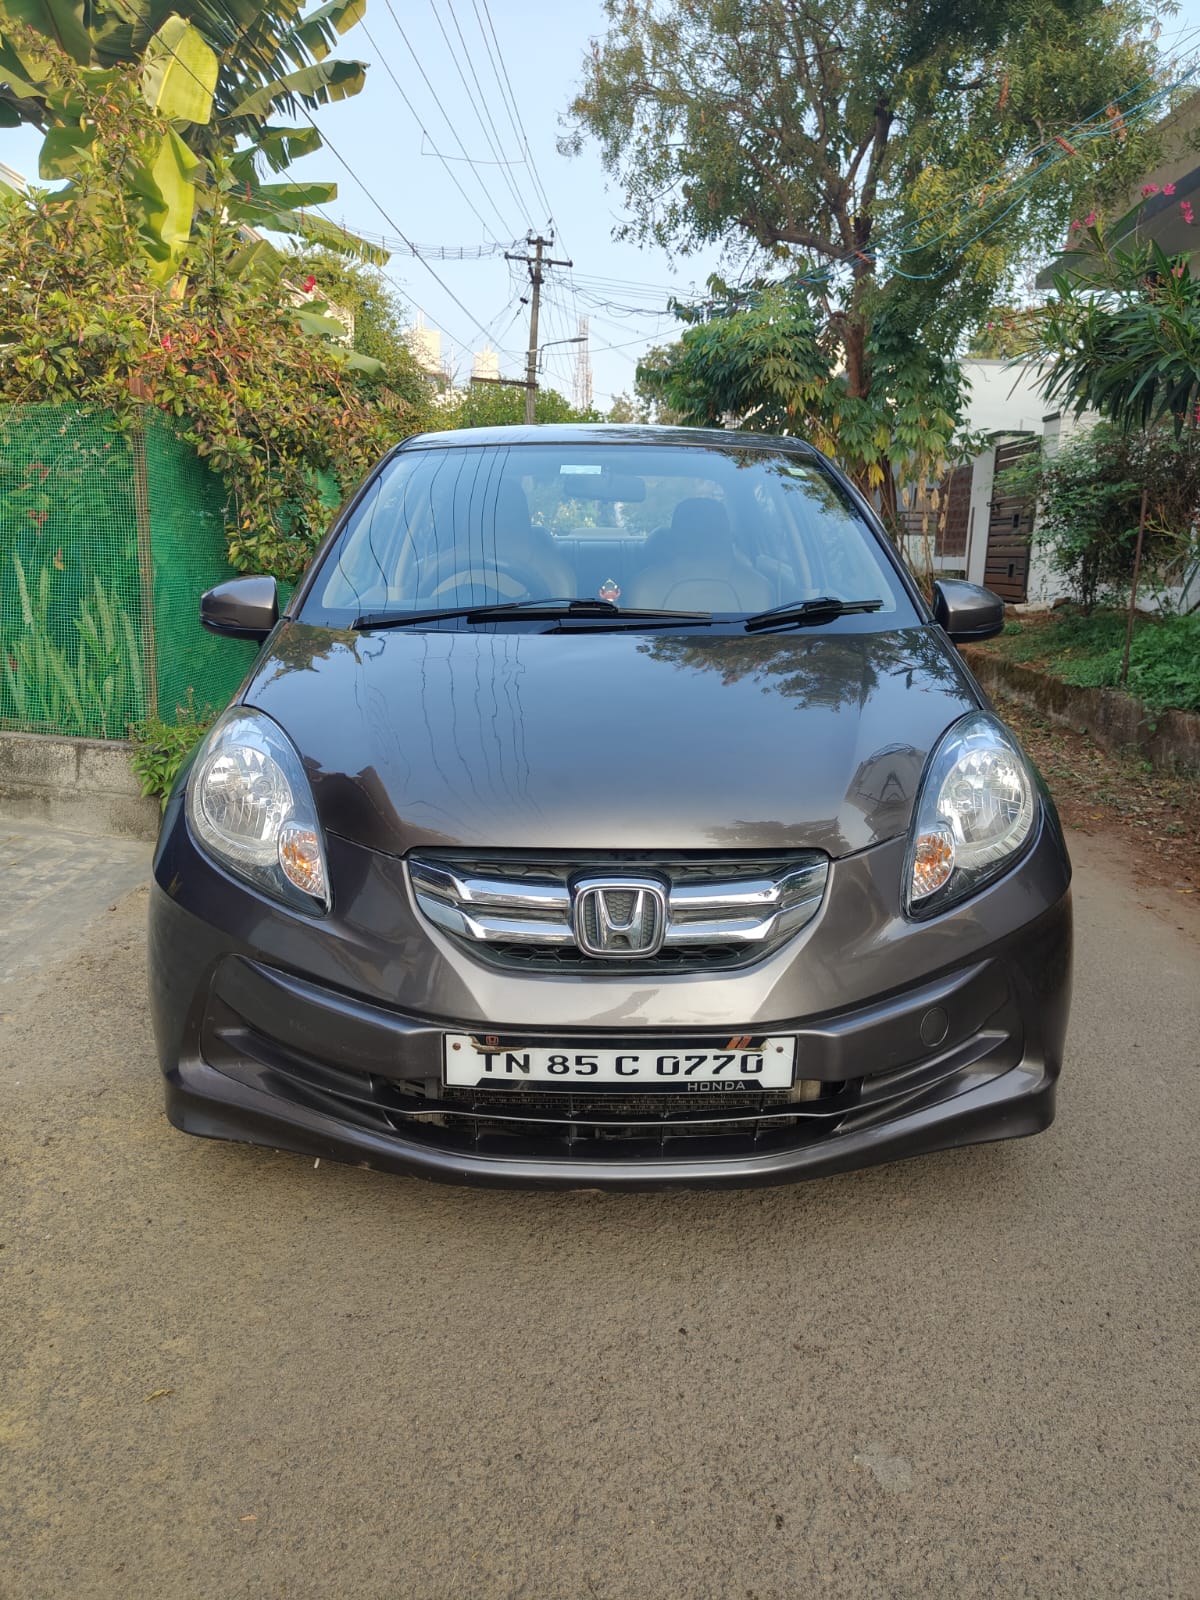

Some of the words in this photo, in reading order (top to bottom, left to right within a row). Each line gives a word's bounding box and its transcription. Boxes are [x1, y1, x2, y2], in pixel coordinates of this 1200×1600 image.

[477, 1052, 530, 1074] TN
[547, 1055, 599, 1076] 85
[615, 1055, 640, 1076] C
[656, 1054, 764, 1076] 0770
[687, 1081, 746, 1092] HONDA
